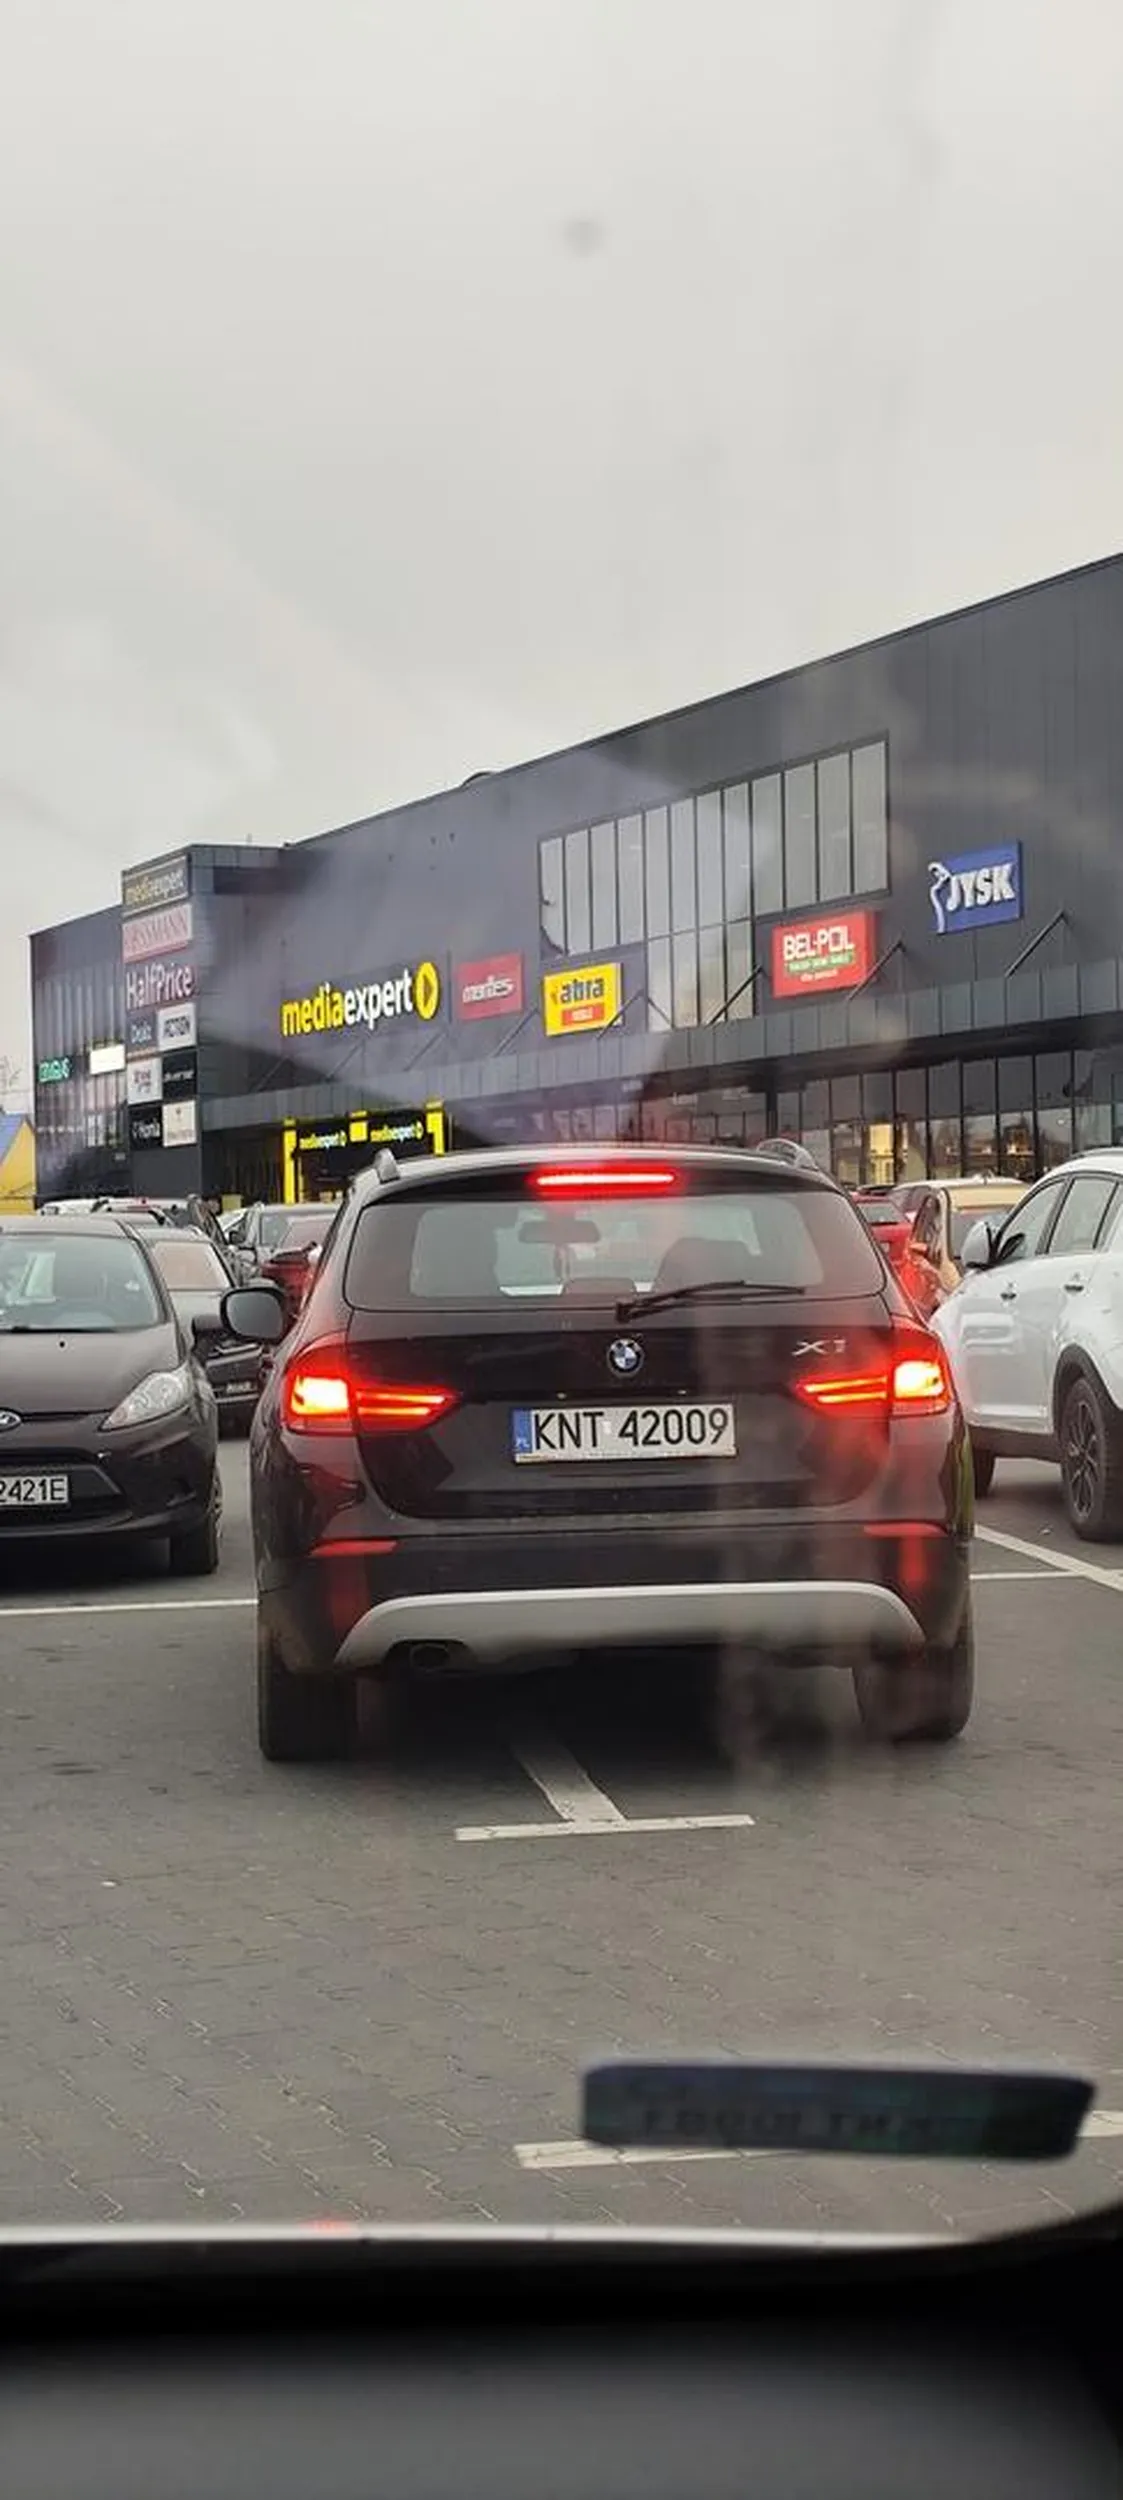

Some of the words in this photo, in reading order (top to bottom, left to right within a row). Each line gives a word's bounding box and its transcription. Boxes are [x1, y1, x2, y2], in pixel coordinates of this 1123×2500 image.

[946, 863, 1015, 911] JYSK
[783, 926, 854, 960] BEL-POL
[127, 962, 192, 1009] HalfPrice
[281, 968, 413, 1036] mediaexpert
[560, 978, 604, 1003] abra
[534, 1410, 604, 1450] KNT
[618, 1407, 728, 1447] 42009
